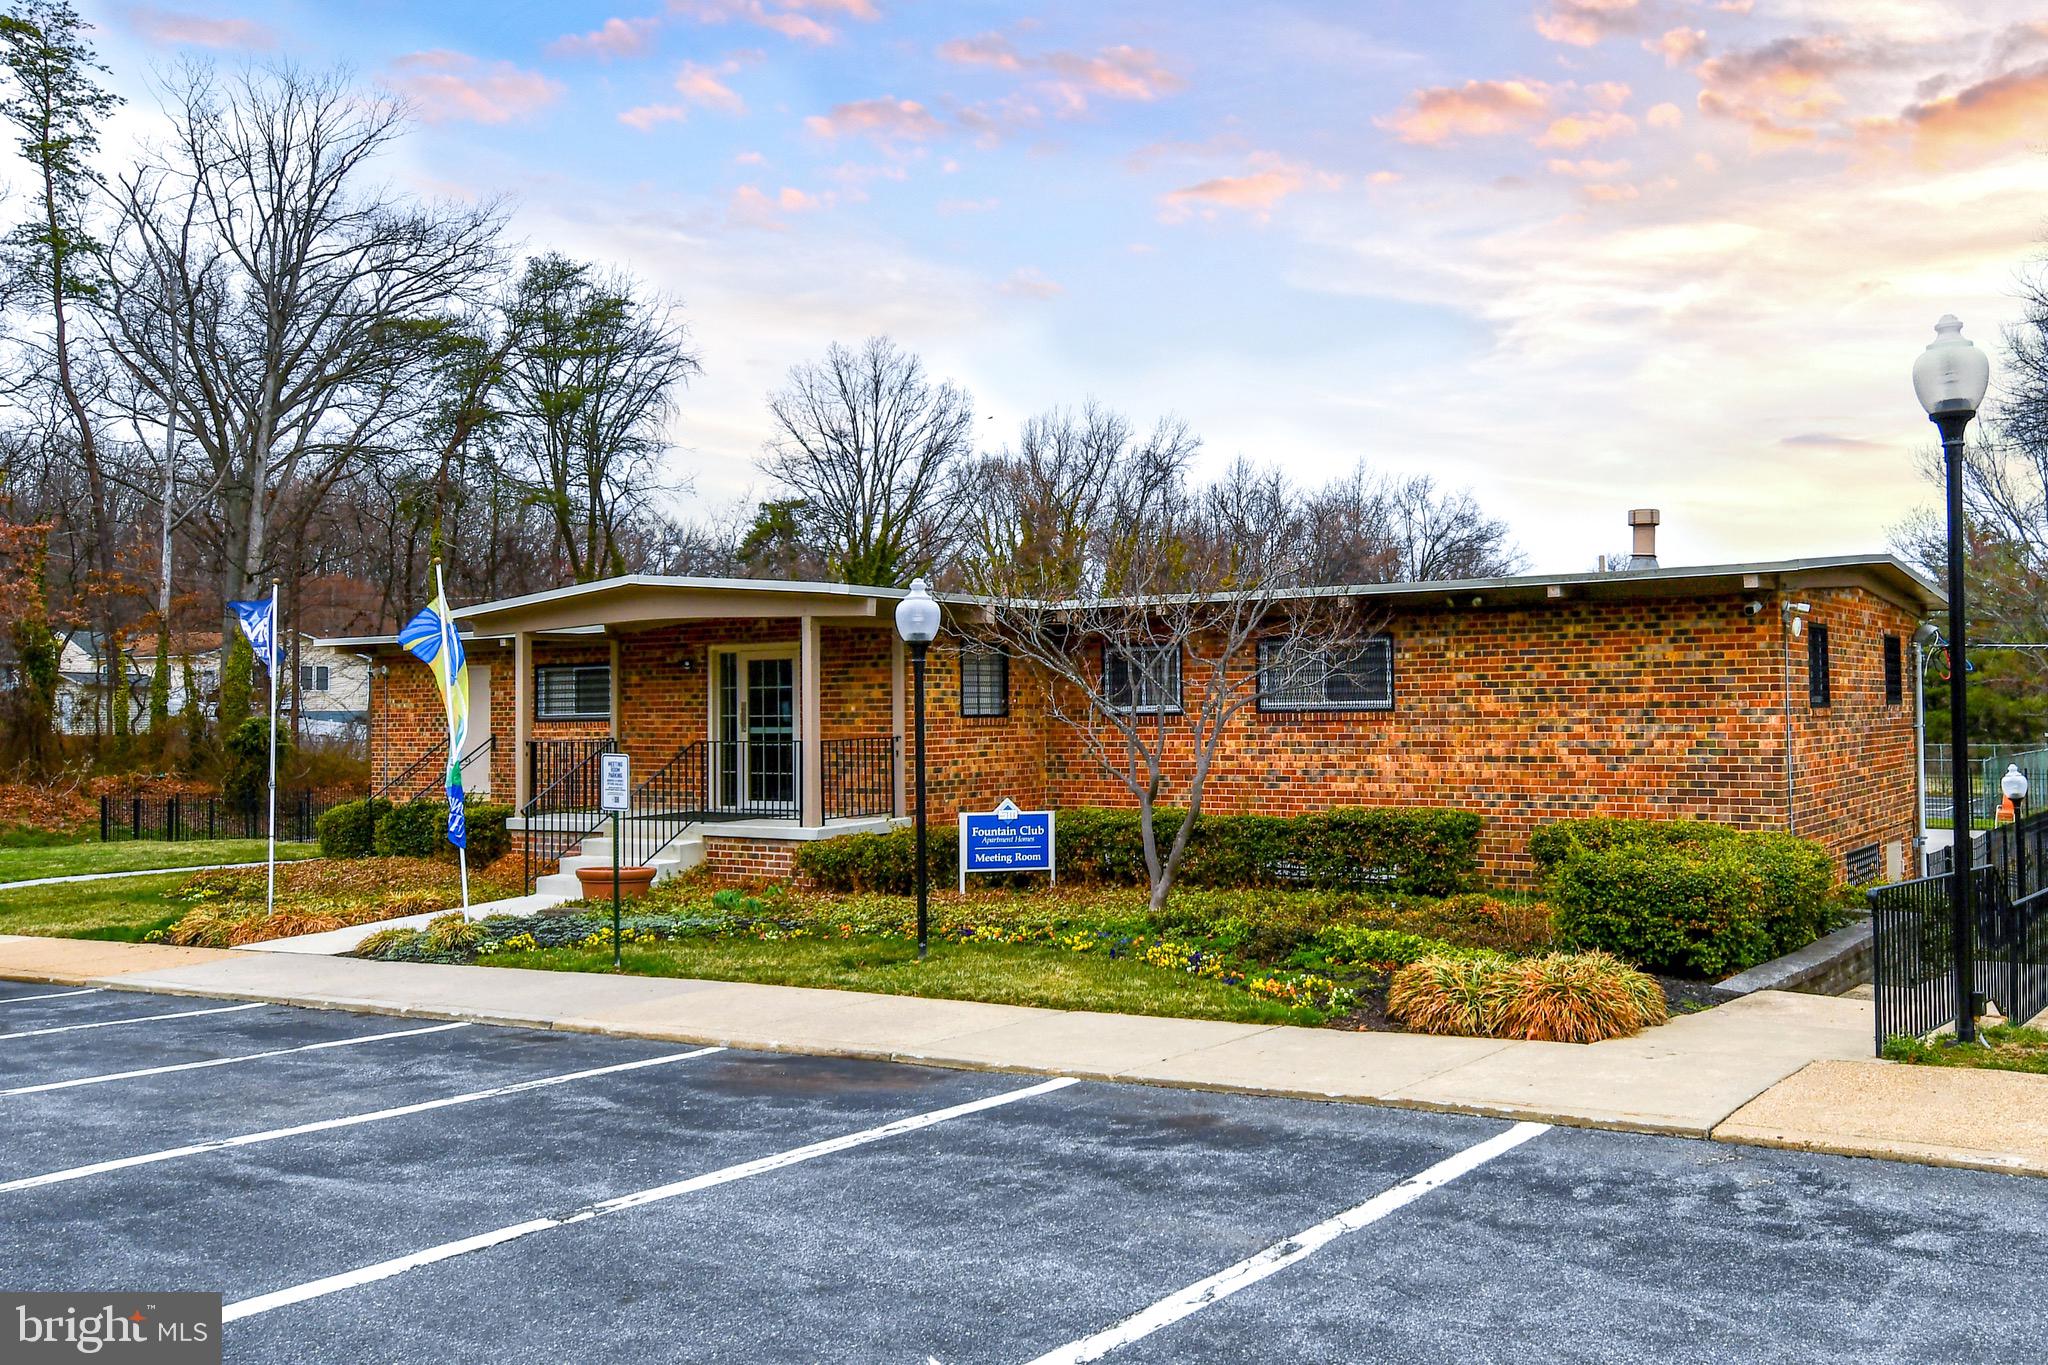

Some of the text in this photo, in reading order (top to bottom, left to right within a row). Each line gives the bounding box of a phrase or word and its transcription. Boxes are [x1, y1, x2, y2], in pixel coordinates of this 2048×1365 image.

[972, 825, 1044, 837] Fountain Club
[981, 836, 1013, 845] Apartment
[975, 852, 1041, 864] Meeting Room
